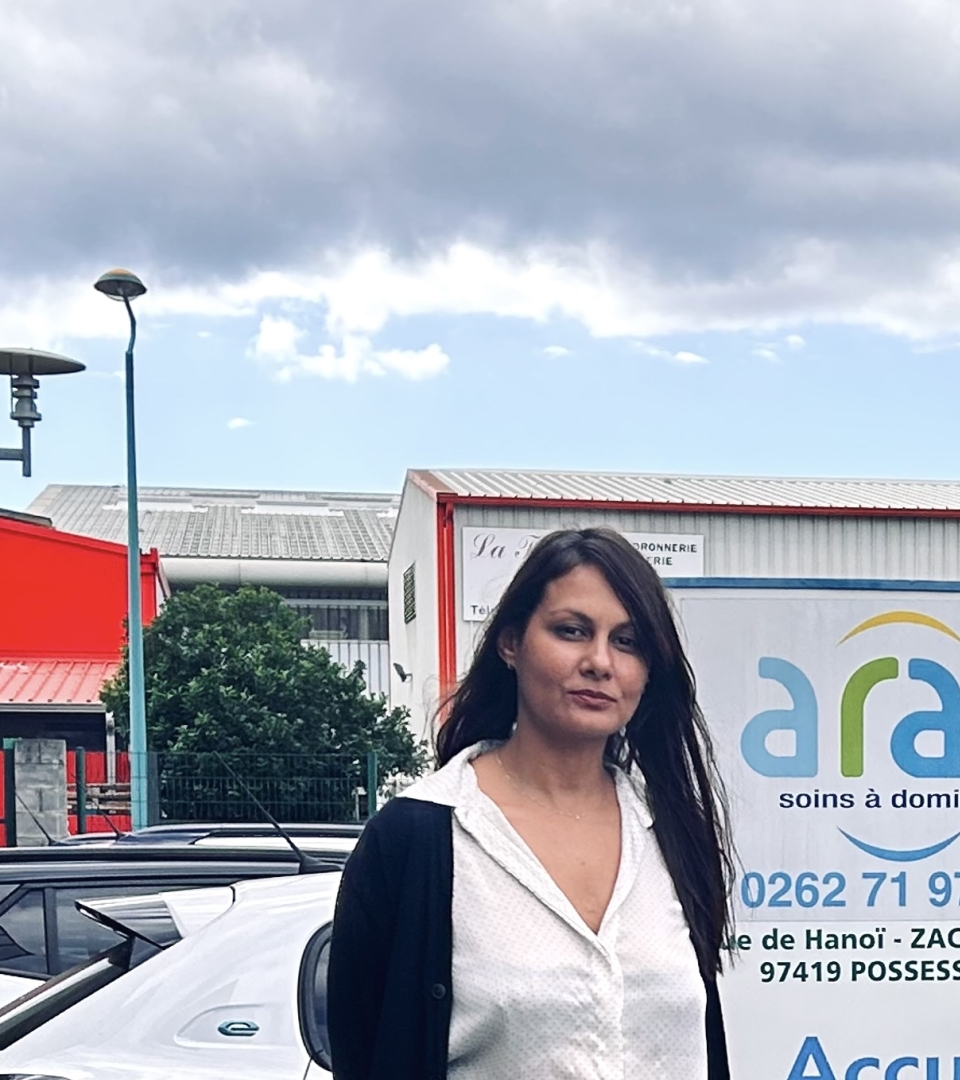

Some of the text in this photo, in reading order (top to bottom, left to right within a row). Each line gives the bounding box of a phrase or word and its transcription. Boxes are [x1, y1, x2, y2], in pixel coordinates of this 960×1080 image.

[779, 788, 855, 809] soins
[864, 787, 882, 809] à
[740, 871, 847, 909] 0262
[861, 871, 907, 908] 71
[761, 927, 796, 950] de
[805, 927, 887, 950] Hanoï
[760, 960, 841, 983] 97419
